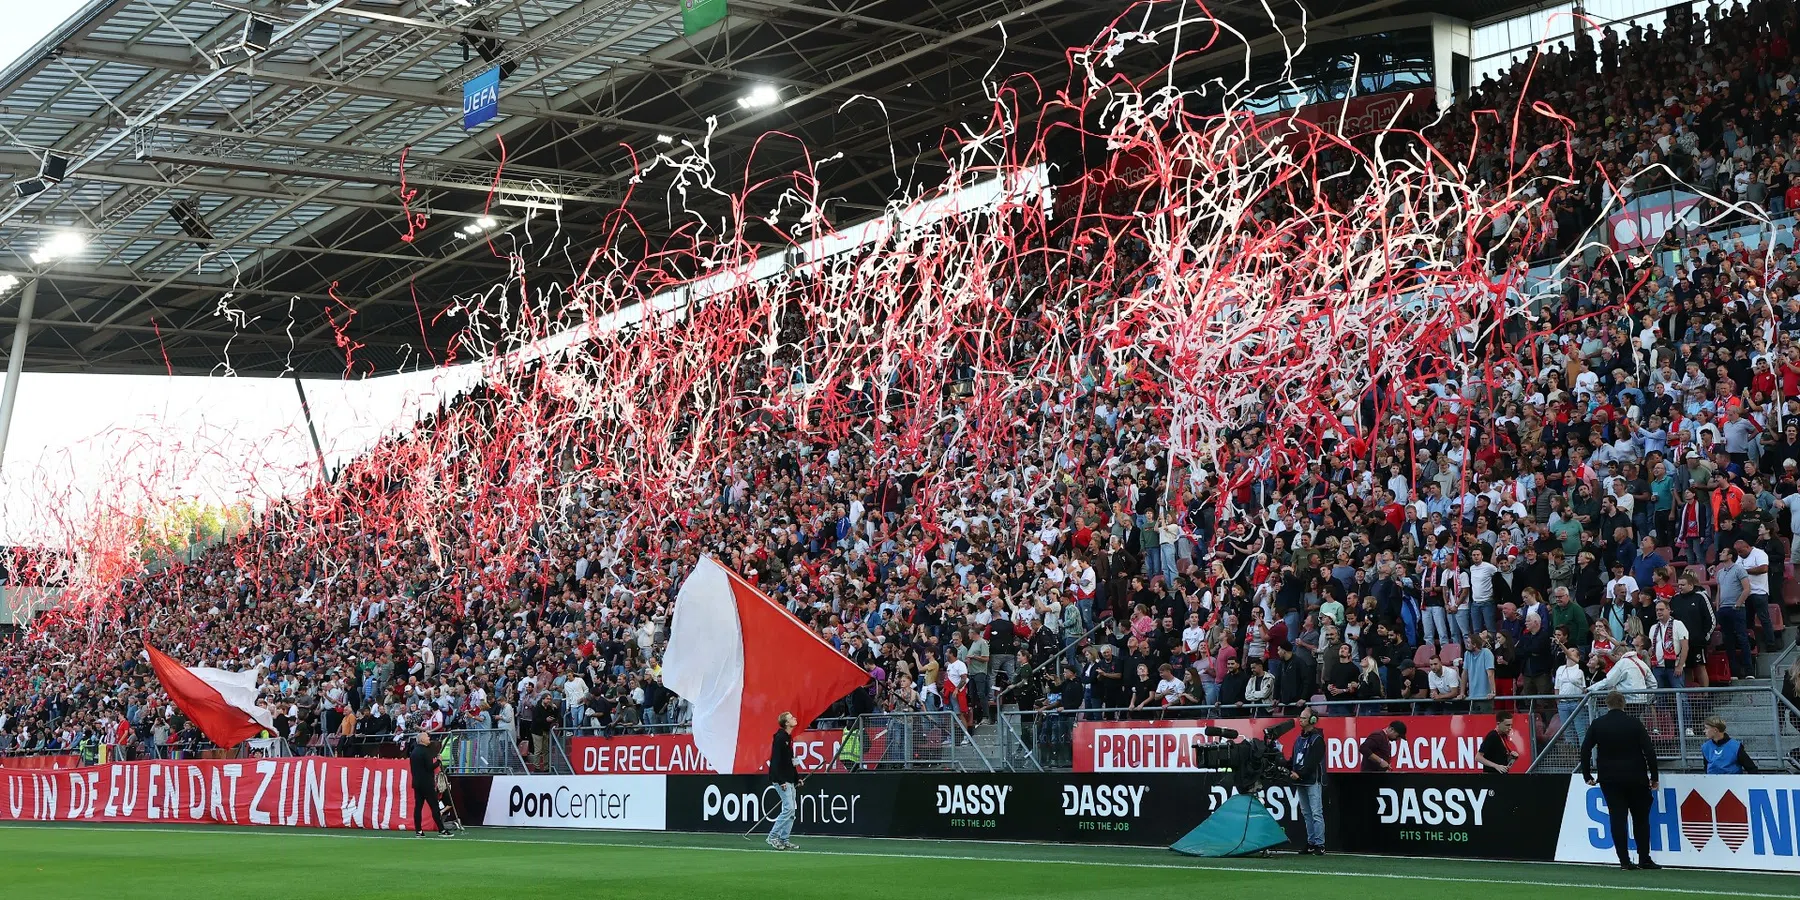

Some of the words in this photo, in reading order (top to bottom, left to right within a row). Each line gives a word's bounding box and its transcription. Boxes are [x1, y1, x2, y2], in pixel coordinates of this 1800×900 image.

[463, 85, 497, 115] UEFA
[583, 746, 611, 772] DE
[8, 775, 24, 819] U
[32, 773, 58, 821] IN
[67, 772, 99, 819] DE
[104, 764, 139, 817] EU
[147, 764, 180, 819] EN
[187, 764, 242, 824] DAT
[509, 785, 631, 819] PonCenter
[951, 818, 966, 827] FITS
[967, 819, 980, 828] THE
[982, 820, 996, 829] JOB
[1079, 821, 1095, 830] FITS
[1097, 821, 1112, 831] THE
[1113, 822, 1130, 831] JOB
[1400, 830, 1421, 841] FITS
[1424, 831, 1444, 842] THE
[1447, 831, 1469, 842] JOB
